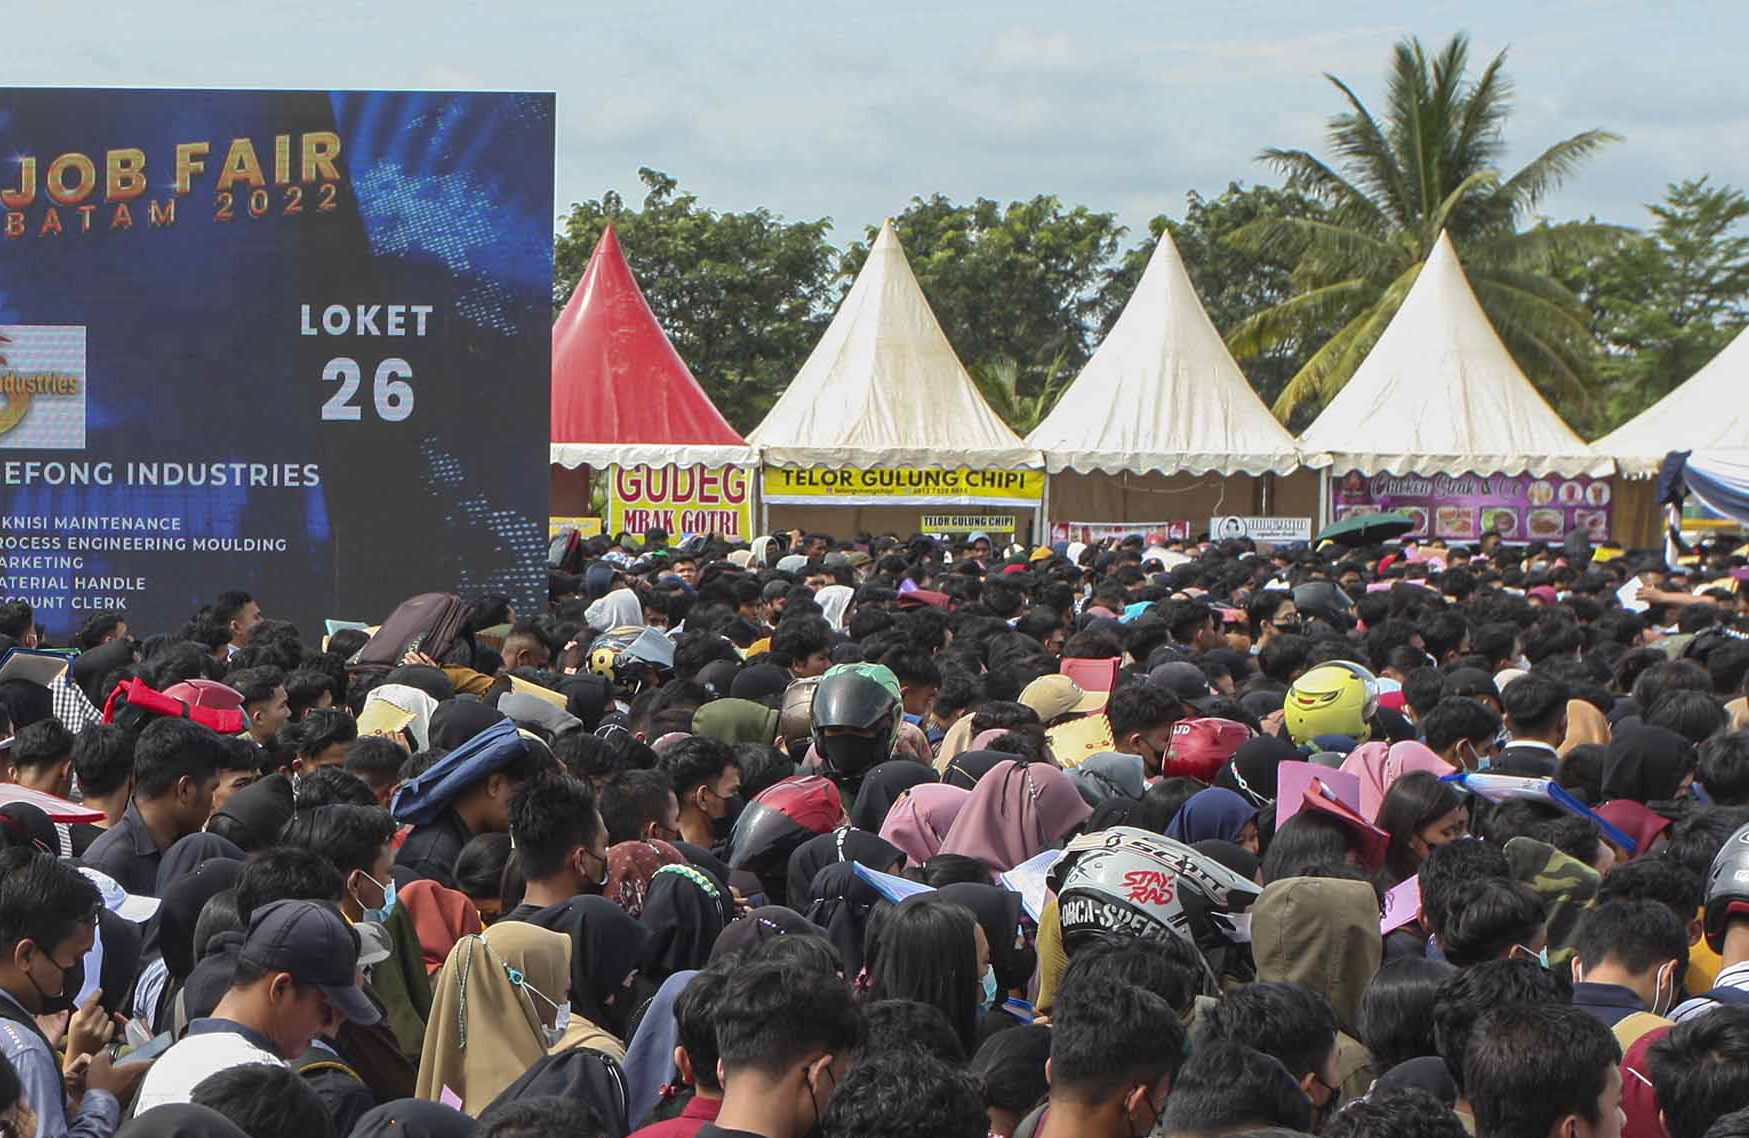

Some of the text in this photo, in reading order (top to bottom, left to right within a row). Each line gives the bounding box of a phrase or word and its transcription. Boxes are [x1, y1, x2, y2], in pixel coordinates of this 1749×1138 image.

[0, 131, 342, 210] JOB FAIR
[5, 183, 339, 239] BATAM 2022
[300, 304, 433, 336] LOKET
[322, 357, 414, 422] 26
[127, 463, 321, 488] INDUSTRIES
[616, 463, 746, 504] GUDEG
[781, 470, 1025, 489] TELOR GULUNG CHIPI
[54, 517, 181, 531] MAINTENANCE
[681, 510, 739, 536] GOTRI
[924, 517, 1013, 527] TELOR GULUNG CHIPI
[68, 537, 186, 551] ENGINEERING
[192, 538, 287, 552] MOULDING
[75, 577, 146, 591] HANDLE
[72, 597, 126, 610] CLERK
[1126, 886, 1174, 906] RAD
